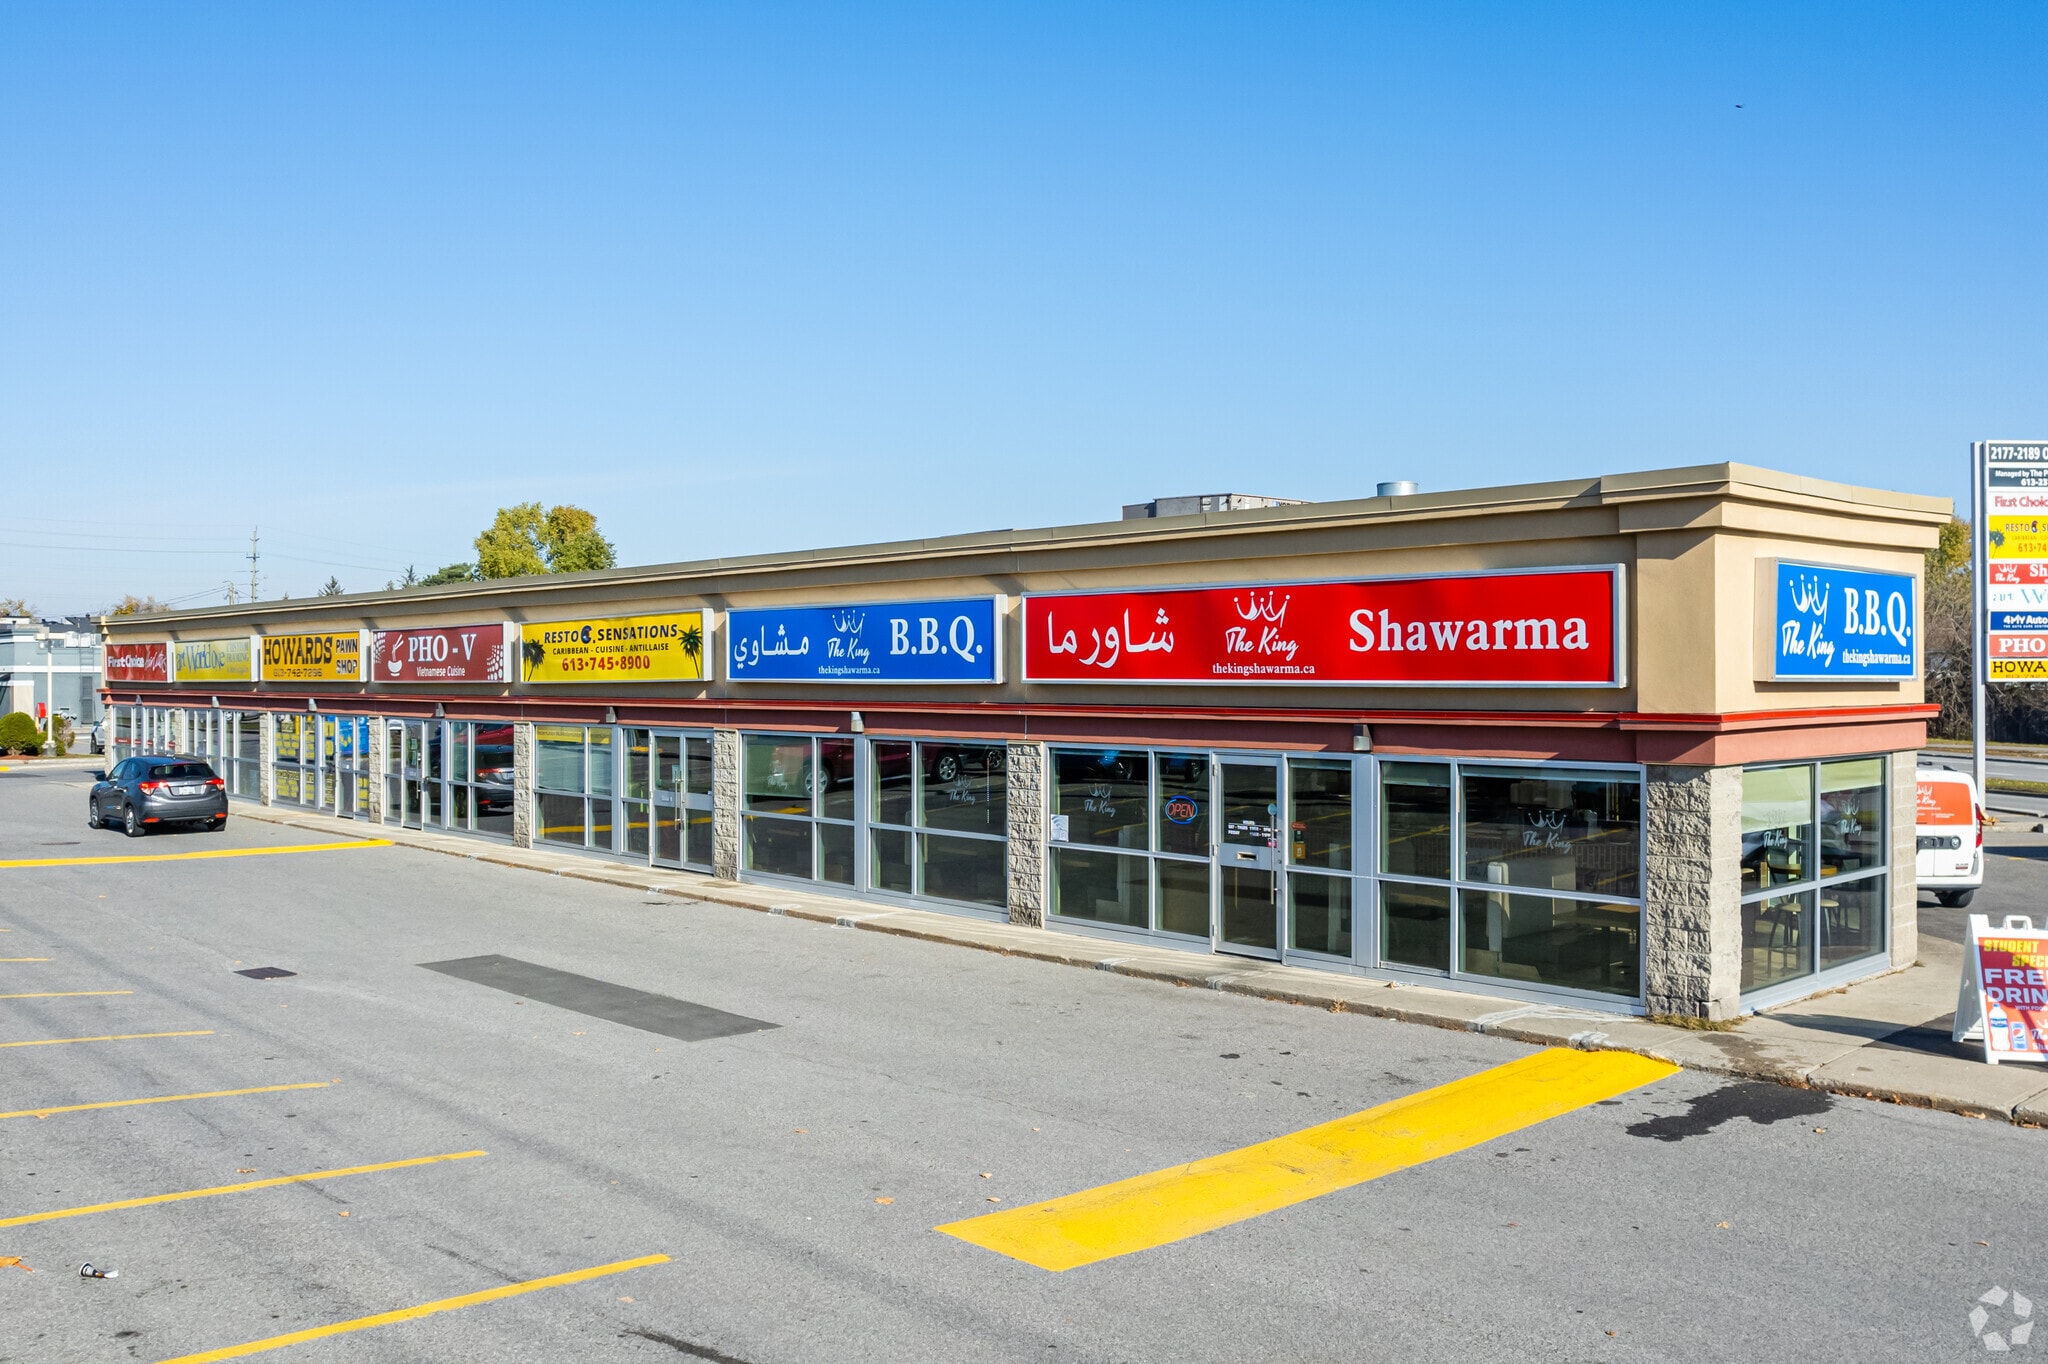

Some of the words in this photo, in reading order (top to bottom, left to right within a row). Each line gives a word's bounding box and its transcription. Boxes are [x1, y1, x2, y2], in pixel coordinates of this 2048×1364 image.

[1990, 446, 2041, 460] 2177-2189
[1994, 469, 2022, 479] Managed
[2022, 469, 2030, 478] by
[2030, 468, 2043, 477] The
[1994, 495, 2018, 507] First
[1995, 572, 2006, 582] The
[2006, 572, 2021, 584] King
[1843, 587, 1912, 648] B.B.Q.
[544, 630, 579, 644] RESTO
[597, 624, 678, 642] SENSATIONS
[1047, 608, 1175, 669] شاورما
[1349, 608, 1590, 652] Shawarma
[336, 638, 358, 653] PAWN
[408, 634, 449, 662] PHO
[461, 633, 477, 661] V
[734, 623, 810, 670] مشاوي
[890, 615, 984, 664] B.B.Q.
[1225, 626, 1255, 654] The
[1258, 626, 1300, 662] King
[1782, 620, 1806, 657] The
[1806, 620, 1836, 668] King
[1998, 637, 2046, 653] PHO
[264, 636, 333, 665] HOWARDS
[552, 646, 589, 656] CARIBBEAN
[595, 644, 624, 654] CUISINE
[629, 642, 670, 652] ANTILLAISE
[827, 636, 846, 659] The
[846, 634, 871, 665] King
[108, 656, 125, 668] First
[125, 654, 144, 668] Choice
[1842, 648, 1911, 668] thekingshawarma.ca
[1992, 660, 2047, 672] HOWA
[336, 660, 358, 674] SHOP
[416, 666, 446, 677] Vietnamese
[446, 666, 466, 677] Cuisine
[818, 665, 881, 676] thekingshawarma.ca
[1212, 662, 1316, 676] thekingshawarma.ca
[1084, 799, 1097, 812] The
[1098, 800, 1116, 818] King
[1167, 803, 1194, 818] OPEN
[1522, 830, 1542, 847] The
[1545, 831, 1573, 854] King
[1984, 939, 2040, 953] STUDENT
[1984, 968, 2048, 986] FRE
